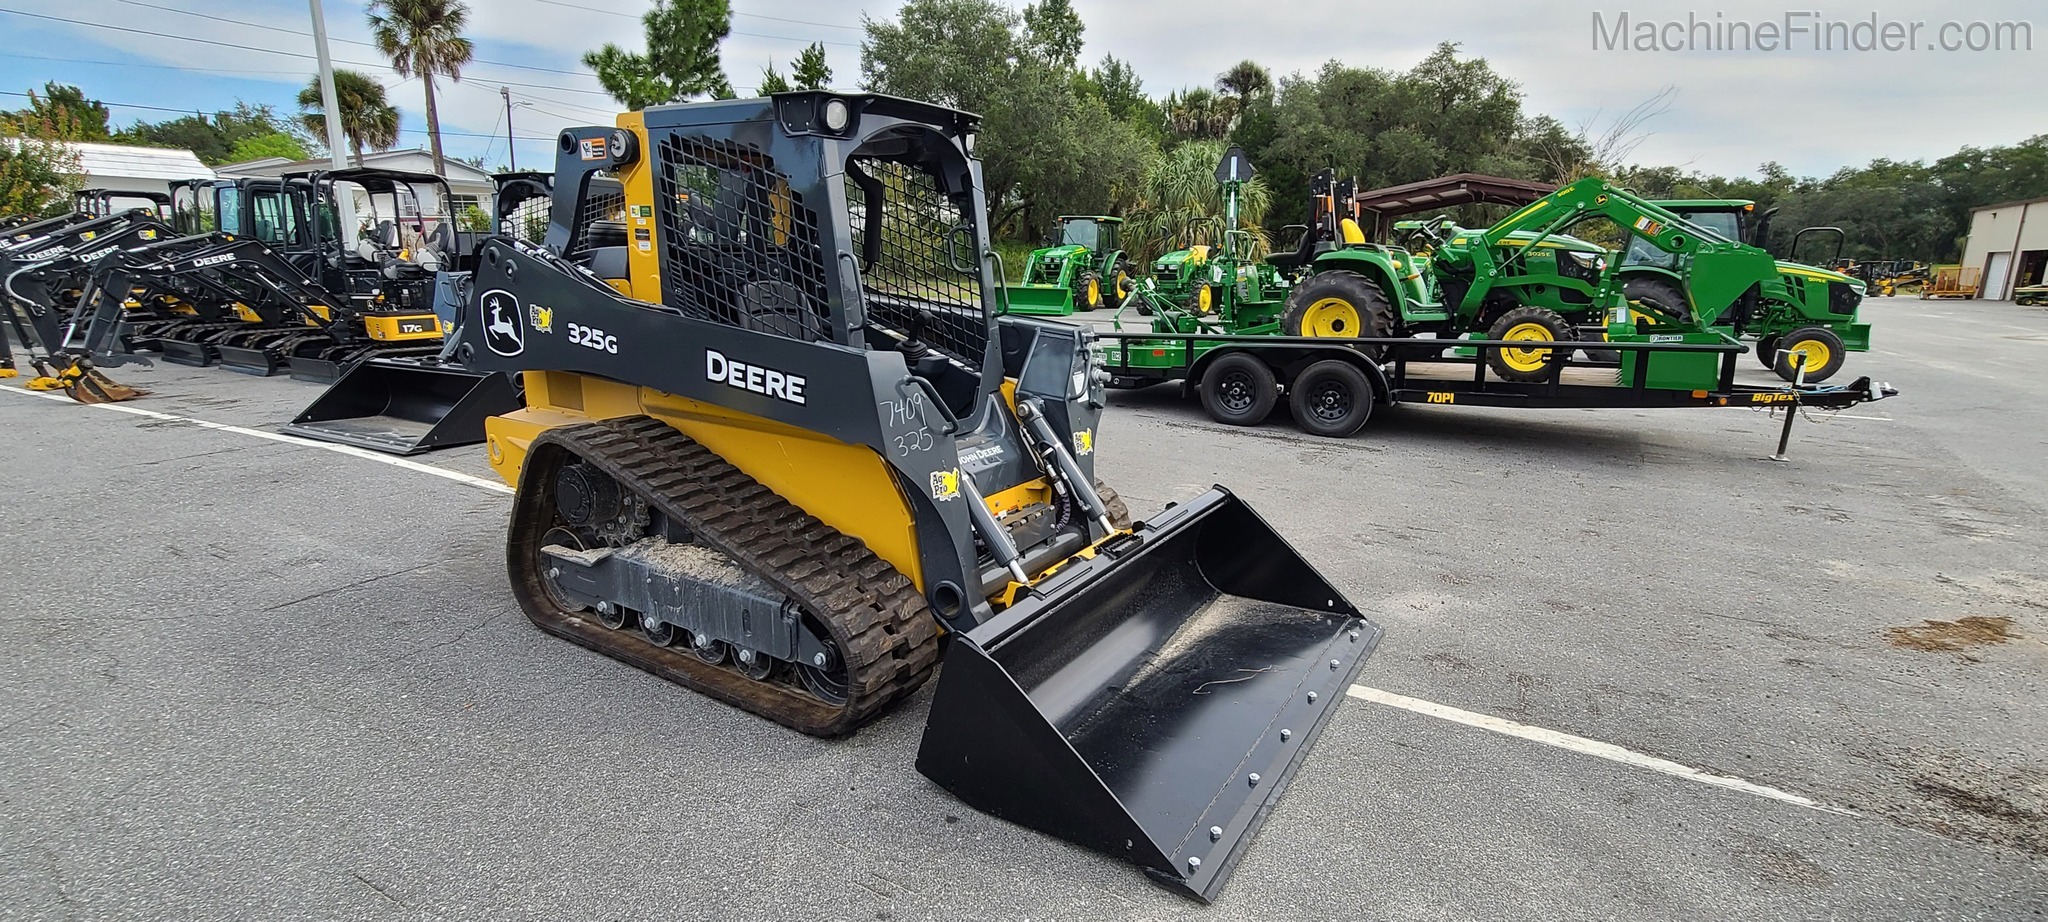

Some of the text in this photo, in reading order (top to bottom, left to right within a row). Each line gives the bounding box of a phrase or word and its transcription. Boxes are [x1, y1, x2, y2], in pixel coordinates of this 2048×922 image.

[193, 253, 236, 267] DEERE
[402, 324, 422, 333] 17G
[568, 322, 618, 354] 325G
[706, 349, 806, 404] DEERE
[880, 393, 927, 428] 7409
[894, 426, 933, 457] 325
[976, 445, 1004, 459] DEERE
[934, 485, 948, 496] Pro
